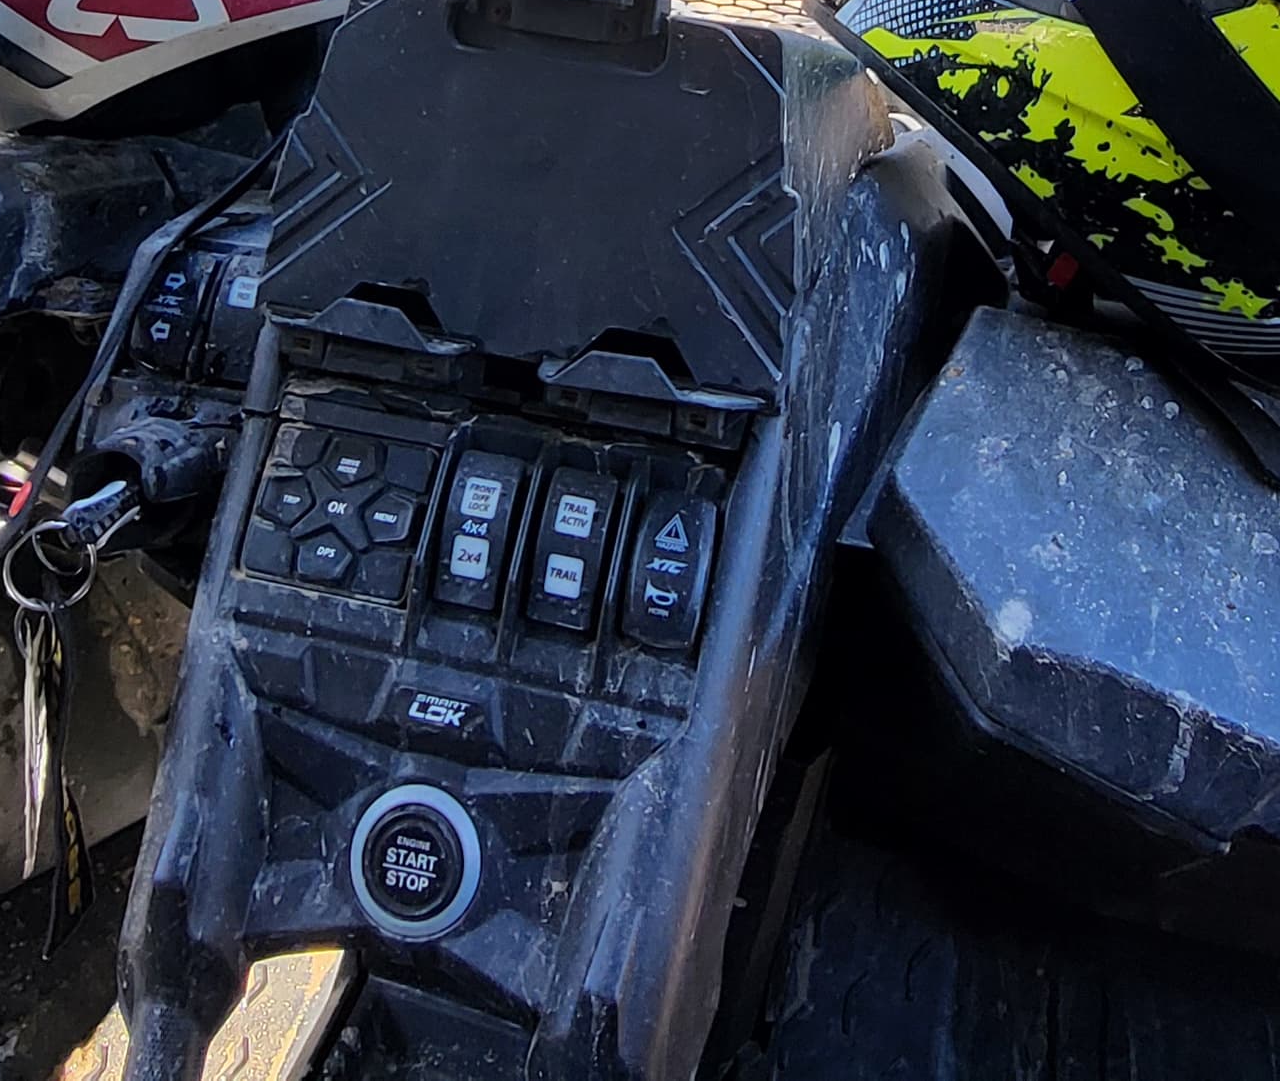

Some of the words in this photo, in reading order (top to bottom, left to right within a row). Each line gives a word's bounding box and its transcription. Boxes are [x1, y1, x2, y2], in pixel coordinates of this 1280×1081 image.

[469, 482, 497, 495] FRONT
[471, 493, 490, 503] DIFF
[327, 501, 348, 515] OK
[467, 501, 491, 513] LOCK
[563, 502, 589, 516] TRAIL
[461, 519, 489, 536] 4x4
[559, 516, 589, 529] ACTIV
[316, 546, 336, 558] DPS
[457, 548, 483, 565] 2x4
[645, 557, 689, 575] XTC
[549, 566, 579, 583] TRAIL
[415, 694, 470, 710] SMART
[408, 701, 466, 727] LOK
[396, 835, 432, 852] ENGINE
[385, 847, 439, 872] START
[385, 871, 431, 893] STOP
